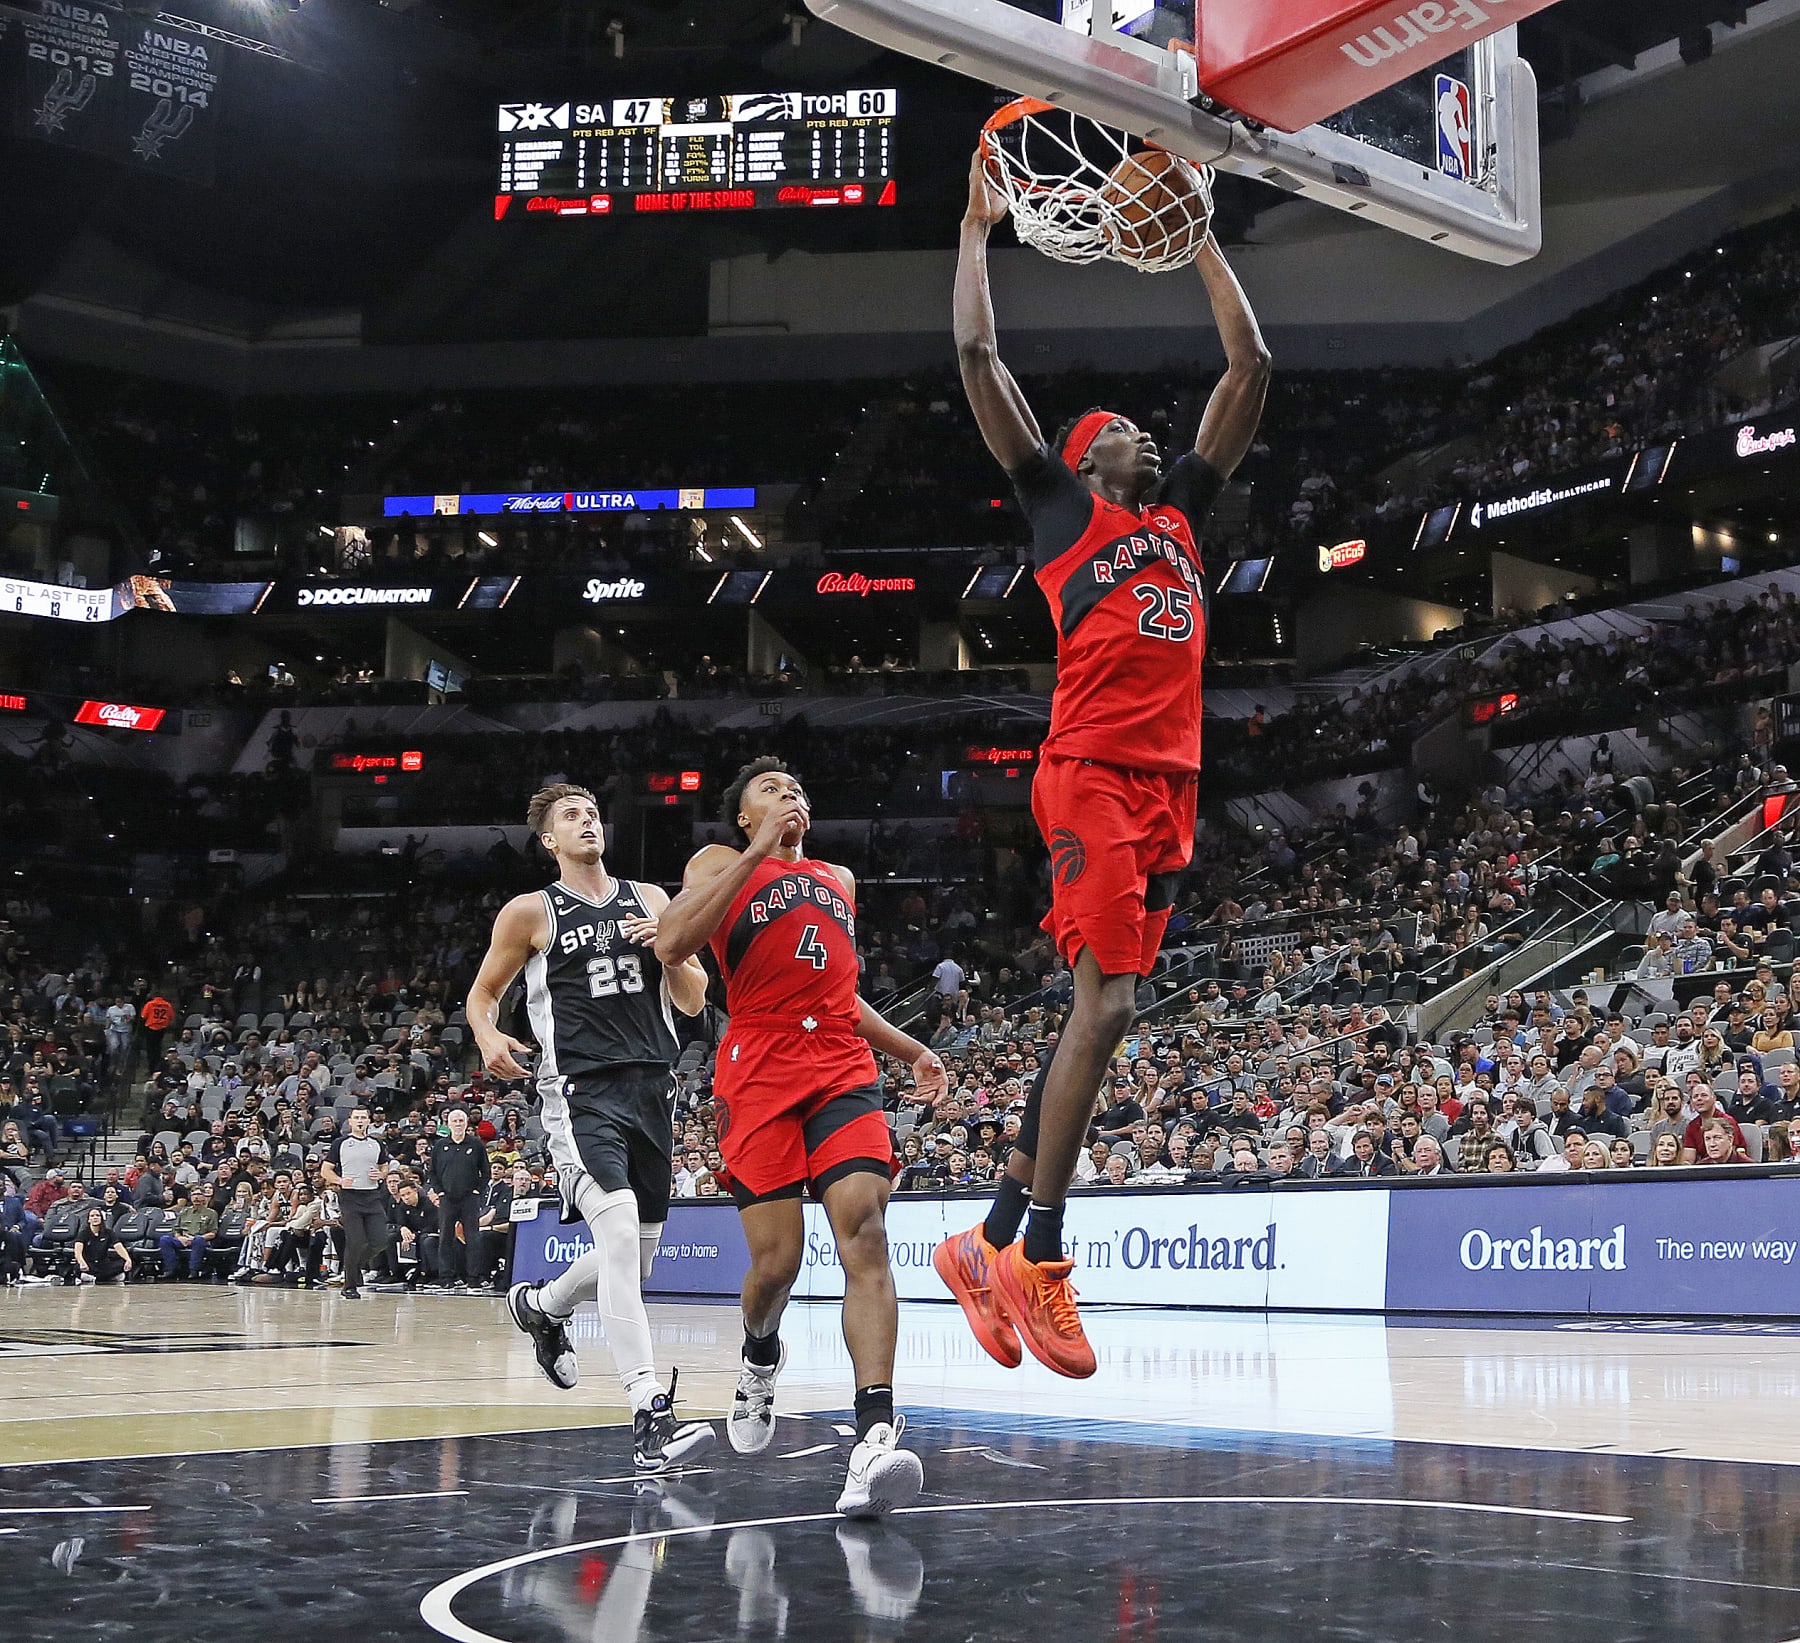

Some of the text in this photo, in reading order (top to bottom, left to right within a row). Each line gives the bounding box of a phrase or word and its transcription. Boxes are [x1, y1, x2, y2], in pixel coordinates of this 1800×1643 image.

[51, 1, 109, 28] NBA
[25, 30, 116, 59] CHAMPIONS
[1339, 0, 1491, 67] Farm
[28, 42, 114, 76] 2013
[137, 42, 207, 70] WESTERN
[153, 33, 208, 61] NBA
[124, 49, 218, 83] CONFERENCE
[128, 60, 214, 92] CHAMPIONS
[130, 72, 209, 108] 2014
[803, 92, 885, 114] TOR 60
[576, 102, 650, 123] SA 47
[806, 120, 826, 128] PTS
[828, 119, 849, 127] REB
[852, 118, 872, 126] AST
[572, 127, 657, 138] PTS REB AST PF
[578, 149, 586, 159] 7
[834, 148, 842, 159] 7
[1440, 152, 1459, 176] NBA
[635, 190, 756, 211] HOME OF THE SPURS
[503, 494, 636, 510] Michelob ULTRA
[1487, 478, 1611, 519] Methodist HEALTHCARE
[1093, 533, 1204, 600] RAPTORS
[5, 583, 106, 604] STL AST REB
[313, 588, 432, 605] DOCUMATION
[582, 577, 645, 603] Sprite
[817, 571, 915, 597] Bally SPORTS
[16, 596, 99, 620] 6 13 24
[1132, 583, 1194, 642] 25
[1459, 646, 1476, 660] 105
[4, 694, 27, 710] LIVE
[98, 703, 141, 725] Bally
[761, 703, 781, 715] 103
[365, 757, 396, 768] SPTS
[1001, 750, 1033, 760] SPTS
[553, 895, 565, 906] 6
[616, 898, 638, 907] Self.
[750, 876, 855, 937] RAPTORS
[560, 919, 635, 954] SPU
[794, 924, 828, 970] 4
[586, 953, 645, 999] 23
[544, 1233, 595, 1264] Orcha
[662, 1245, 680, 1261] way
[681, 1243, 690, 1258] to
[690, 1243, 718, 1259] home
[806, 1231, 842, 1267] $el
[887, 1242, 937, 1268] your
[1060, 1235, 1079, 1268] et
[1458, 1223, 1627, 1271] Orchard
[1655, 1237, 1798, 1264] The new way
